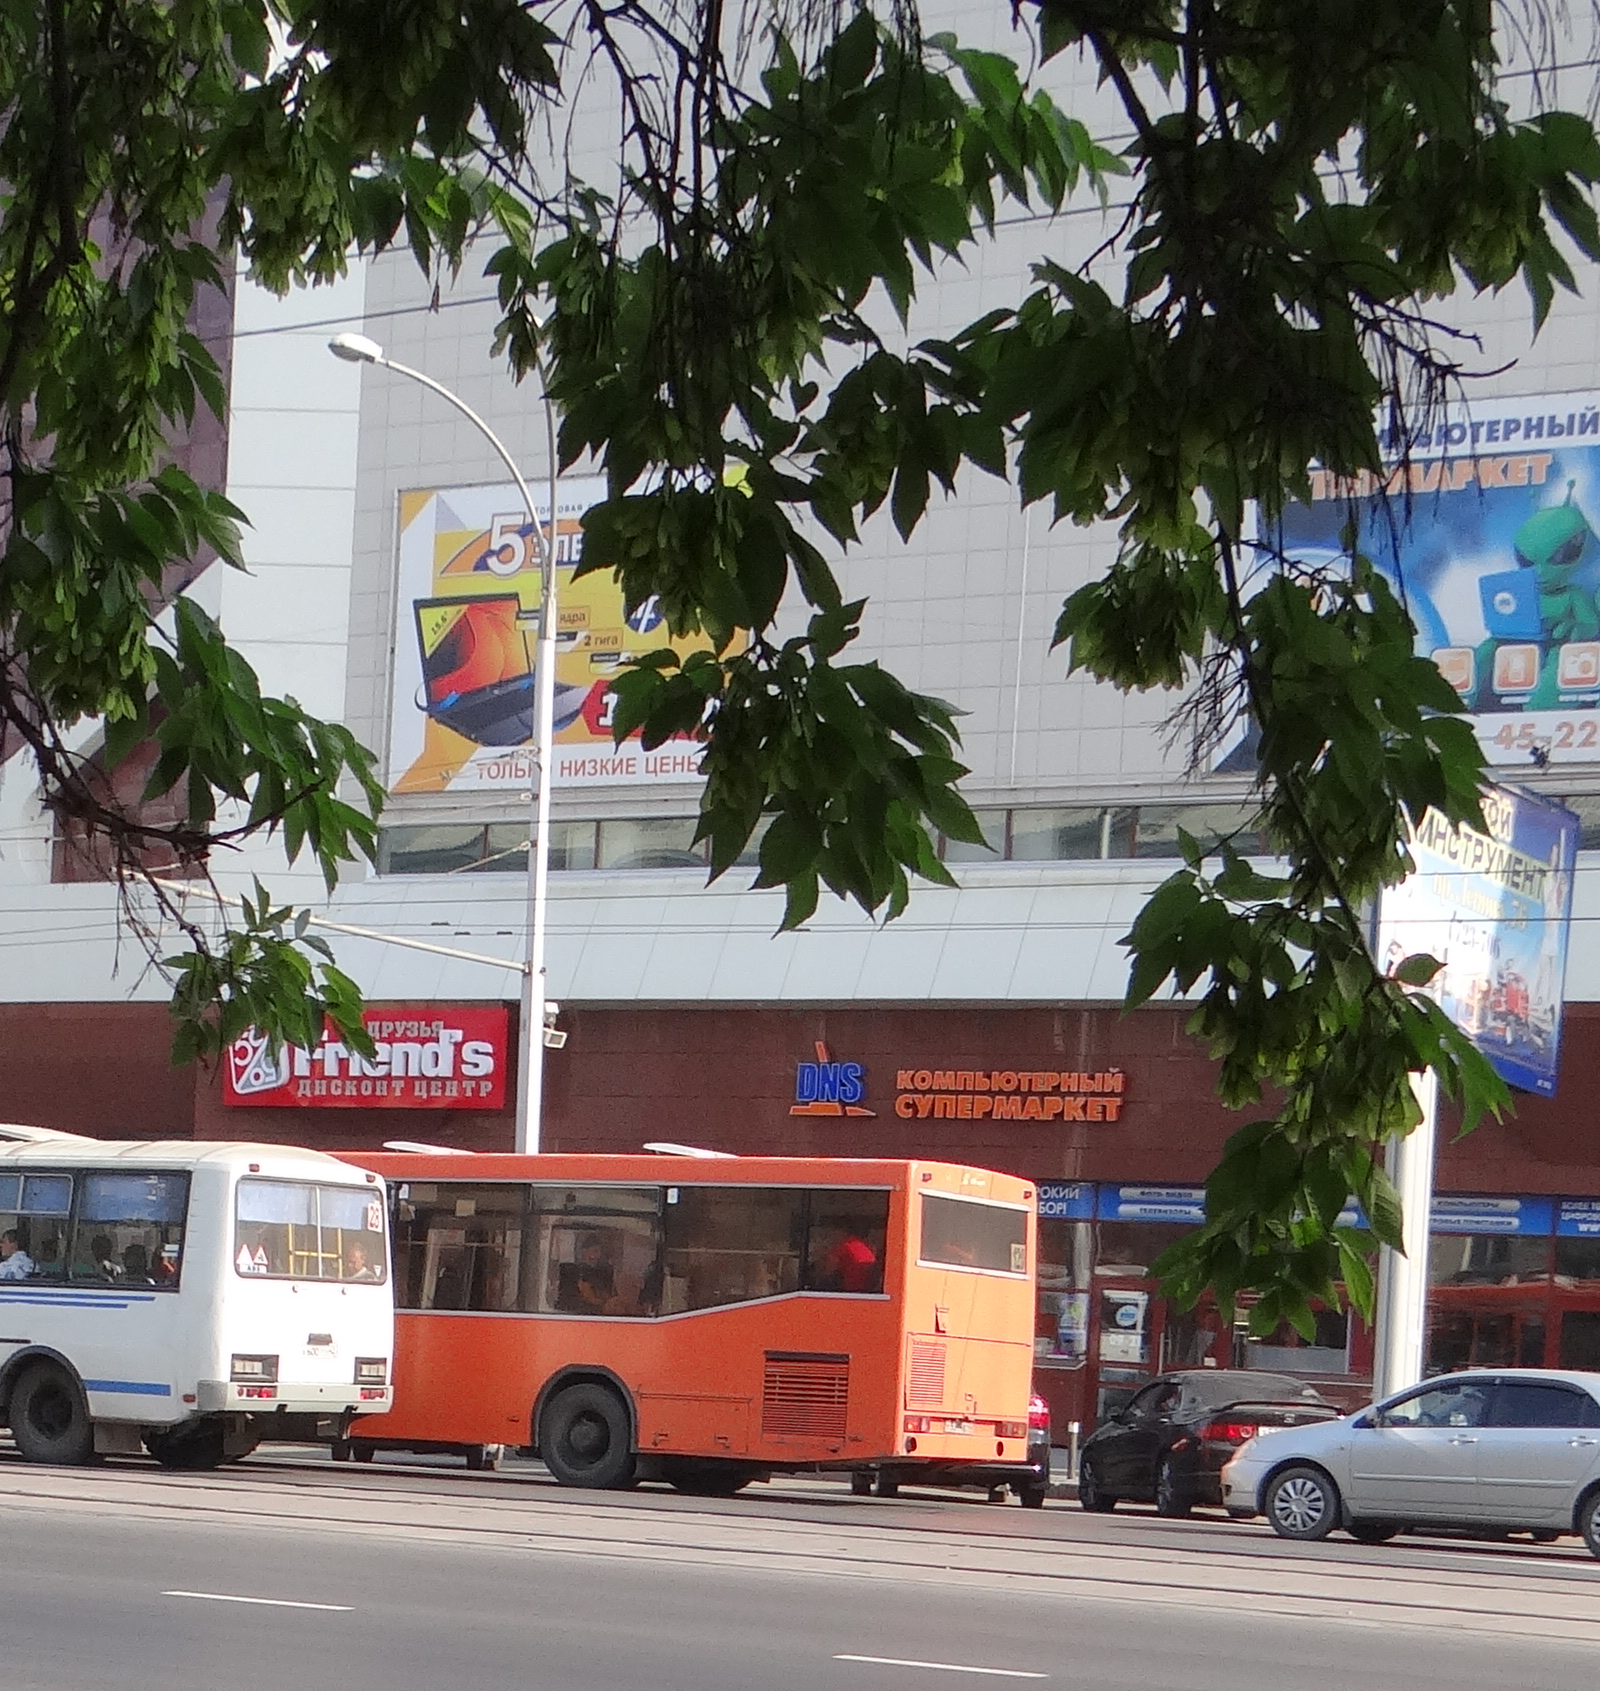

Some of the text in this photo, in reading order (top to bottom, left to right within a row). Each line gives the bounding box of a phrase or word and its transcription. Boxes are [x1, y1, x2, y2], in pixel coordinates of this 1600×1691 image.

[486, 512, 526, 576] 5
[584, 634, 619, 648] 2 гига
[560, 758, 637, 778] НИЗКИЕ
[1419, 810, 1547, 900] ИНСТРУМЕНТ
[293, 1028, 494, 1078] Friend's
[297, 1080, 493, 1099] ДИСКОНТ ЦЕНТР
[796, 1063, 862, 1103] DNS
[896, 1067, 1124, 1093] КОМПЬЮТЕРНЫЙ
[895, 1095, 1122, 1121] СУПЕРМАРКЕТ
